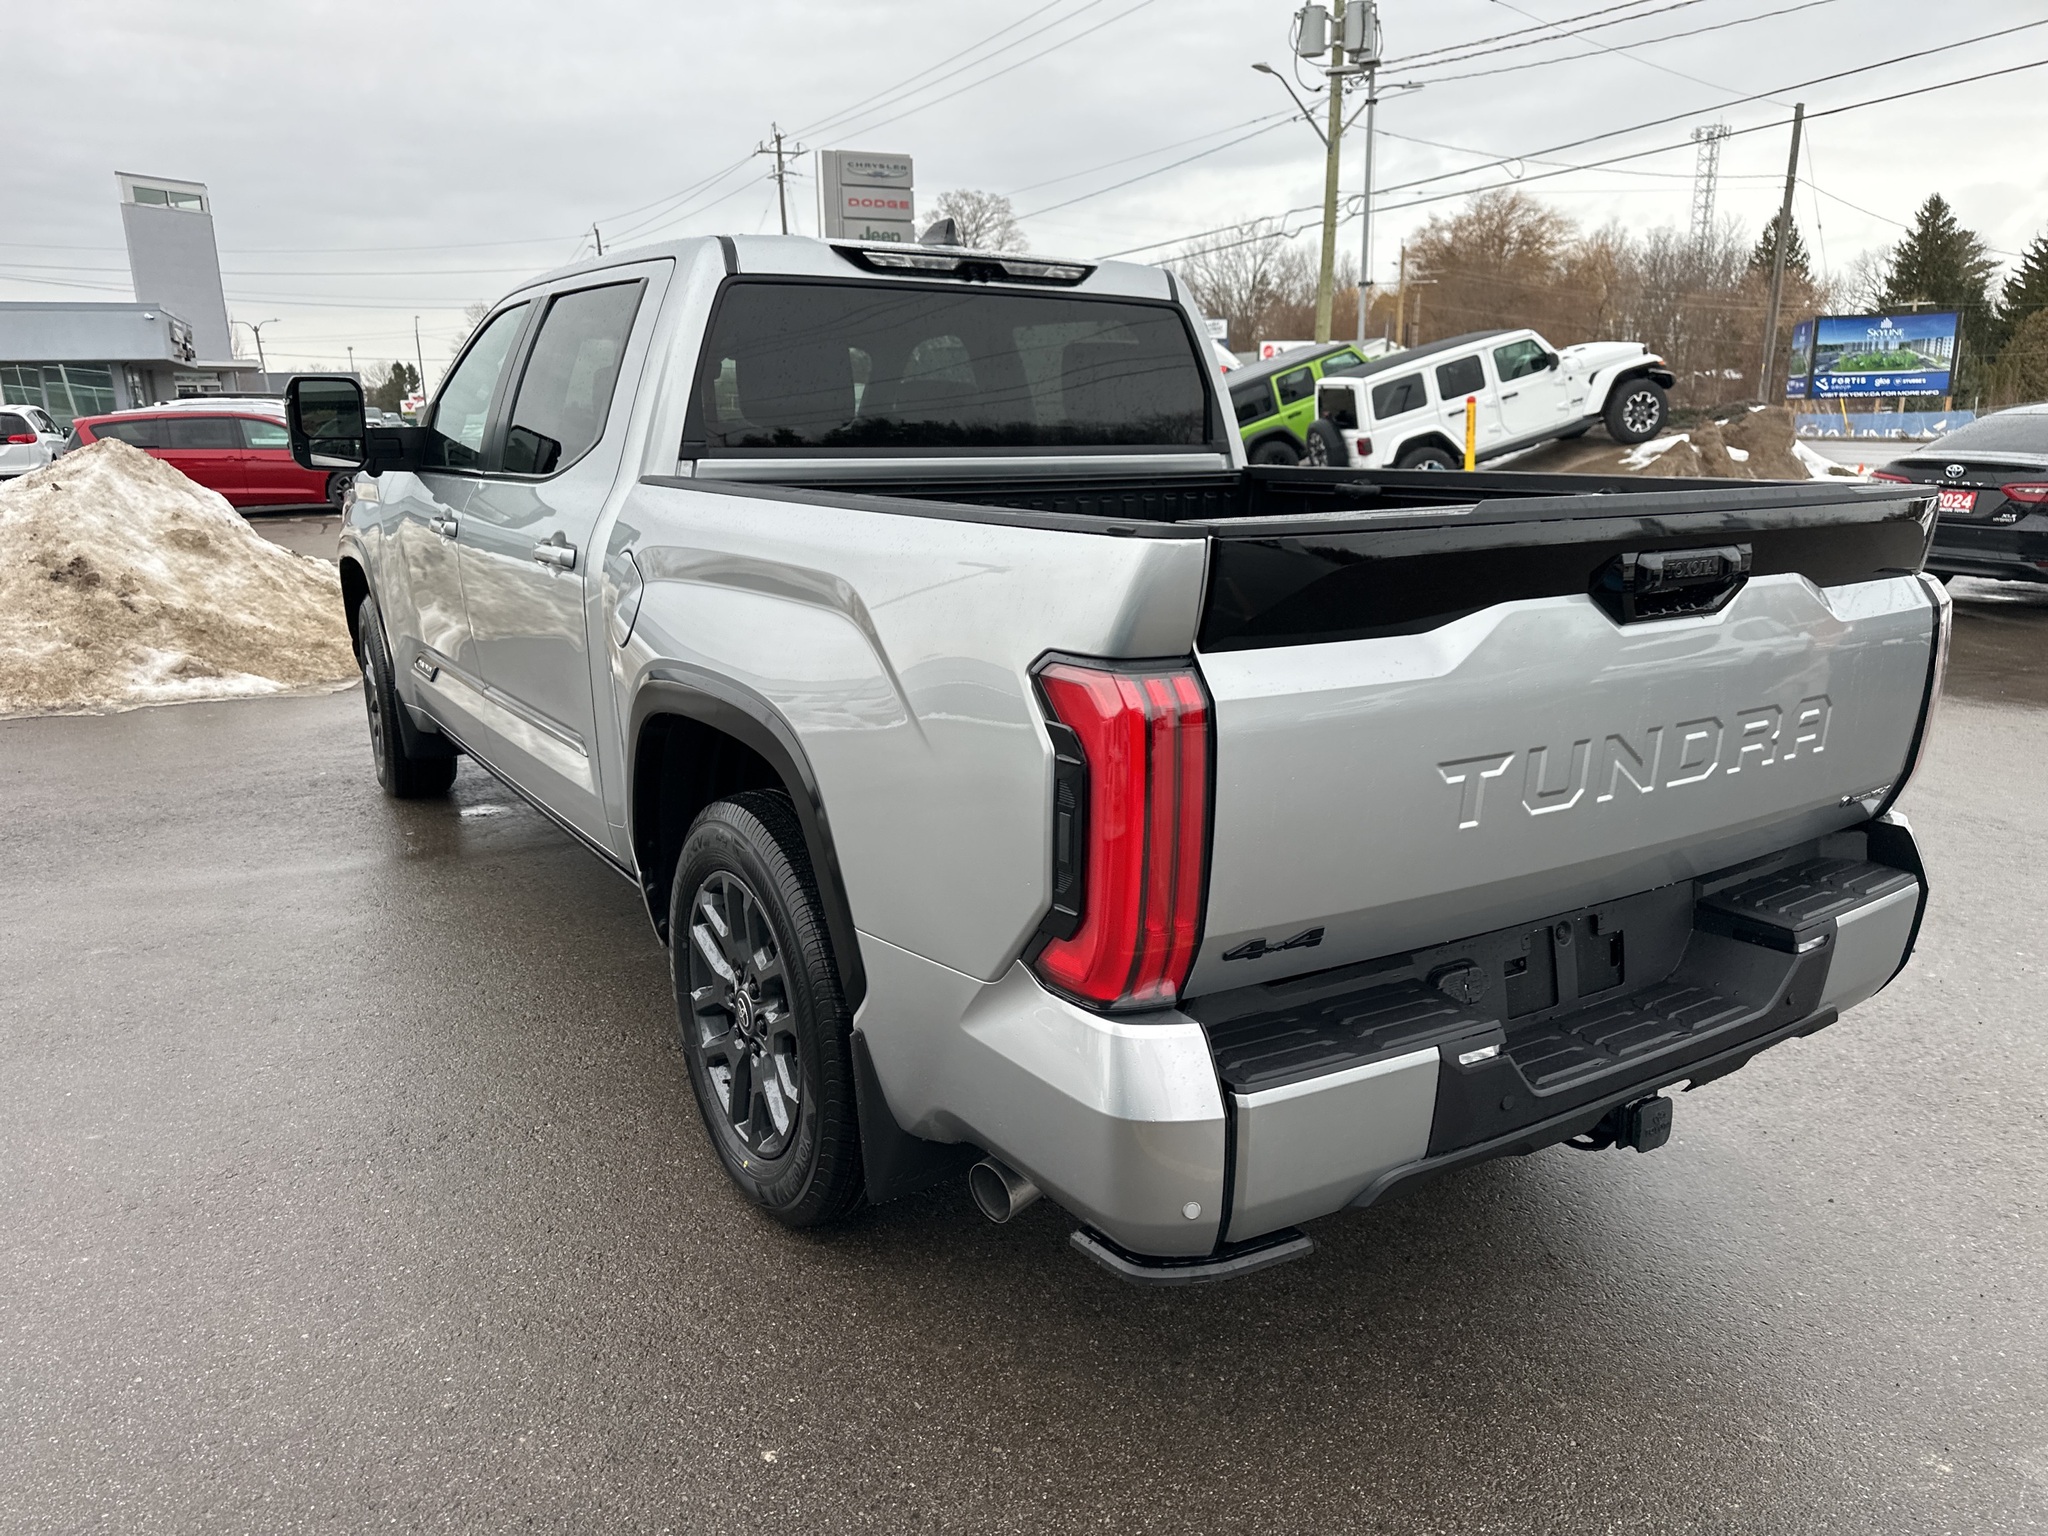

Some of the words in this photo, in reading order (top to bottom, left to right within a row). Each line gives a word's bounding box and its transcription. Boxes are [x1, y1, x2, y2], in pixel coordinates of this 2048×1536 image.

[847, 161, 908, 171] CHRYSLER
[848, 197, 910, 209] DODGE
[859, 226, 901, 242] Jeep
[1831, 377, 1867, 385] FORTIS
[1924, 478, 1985, 487] CAMRY
[1938, 492, 1973, 509] 2024
[1667, 559, 1717, 579] TOYOTA
[1437, 693, 1833, 830] TUNDRA
